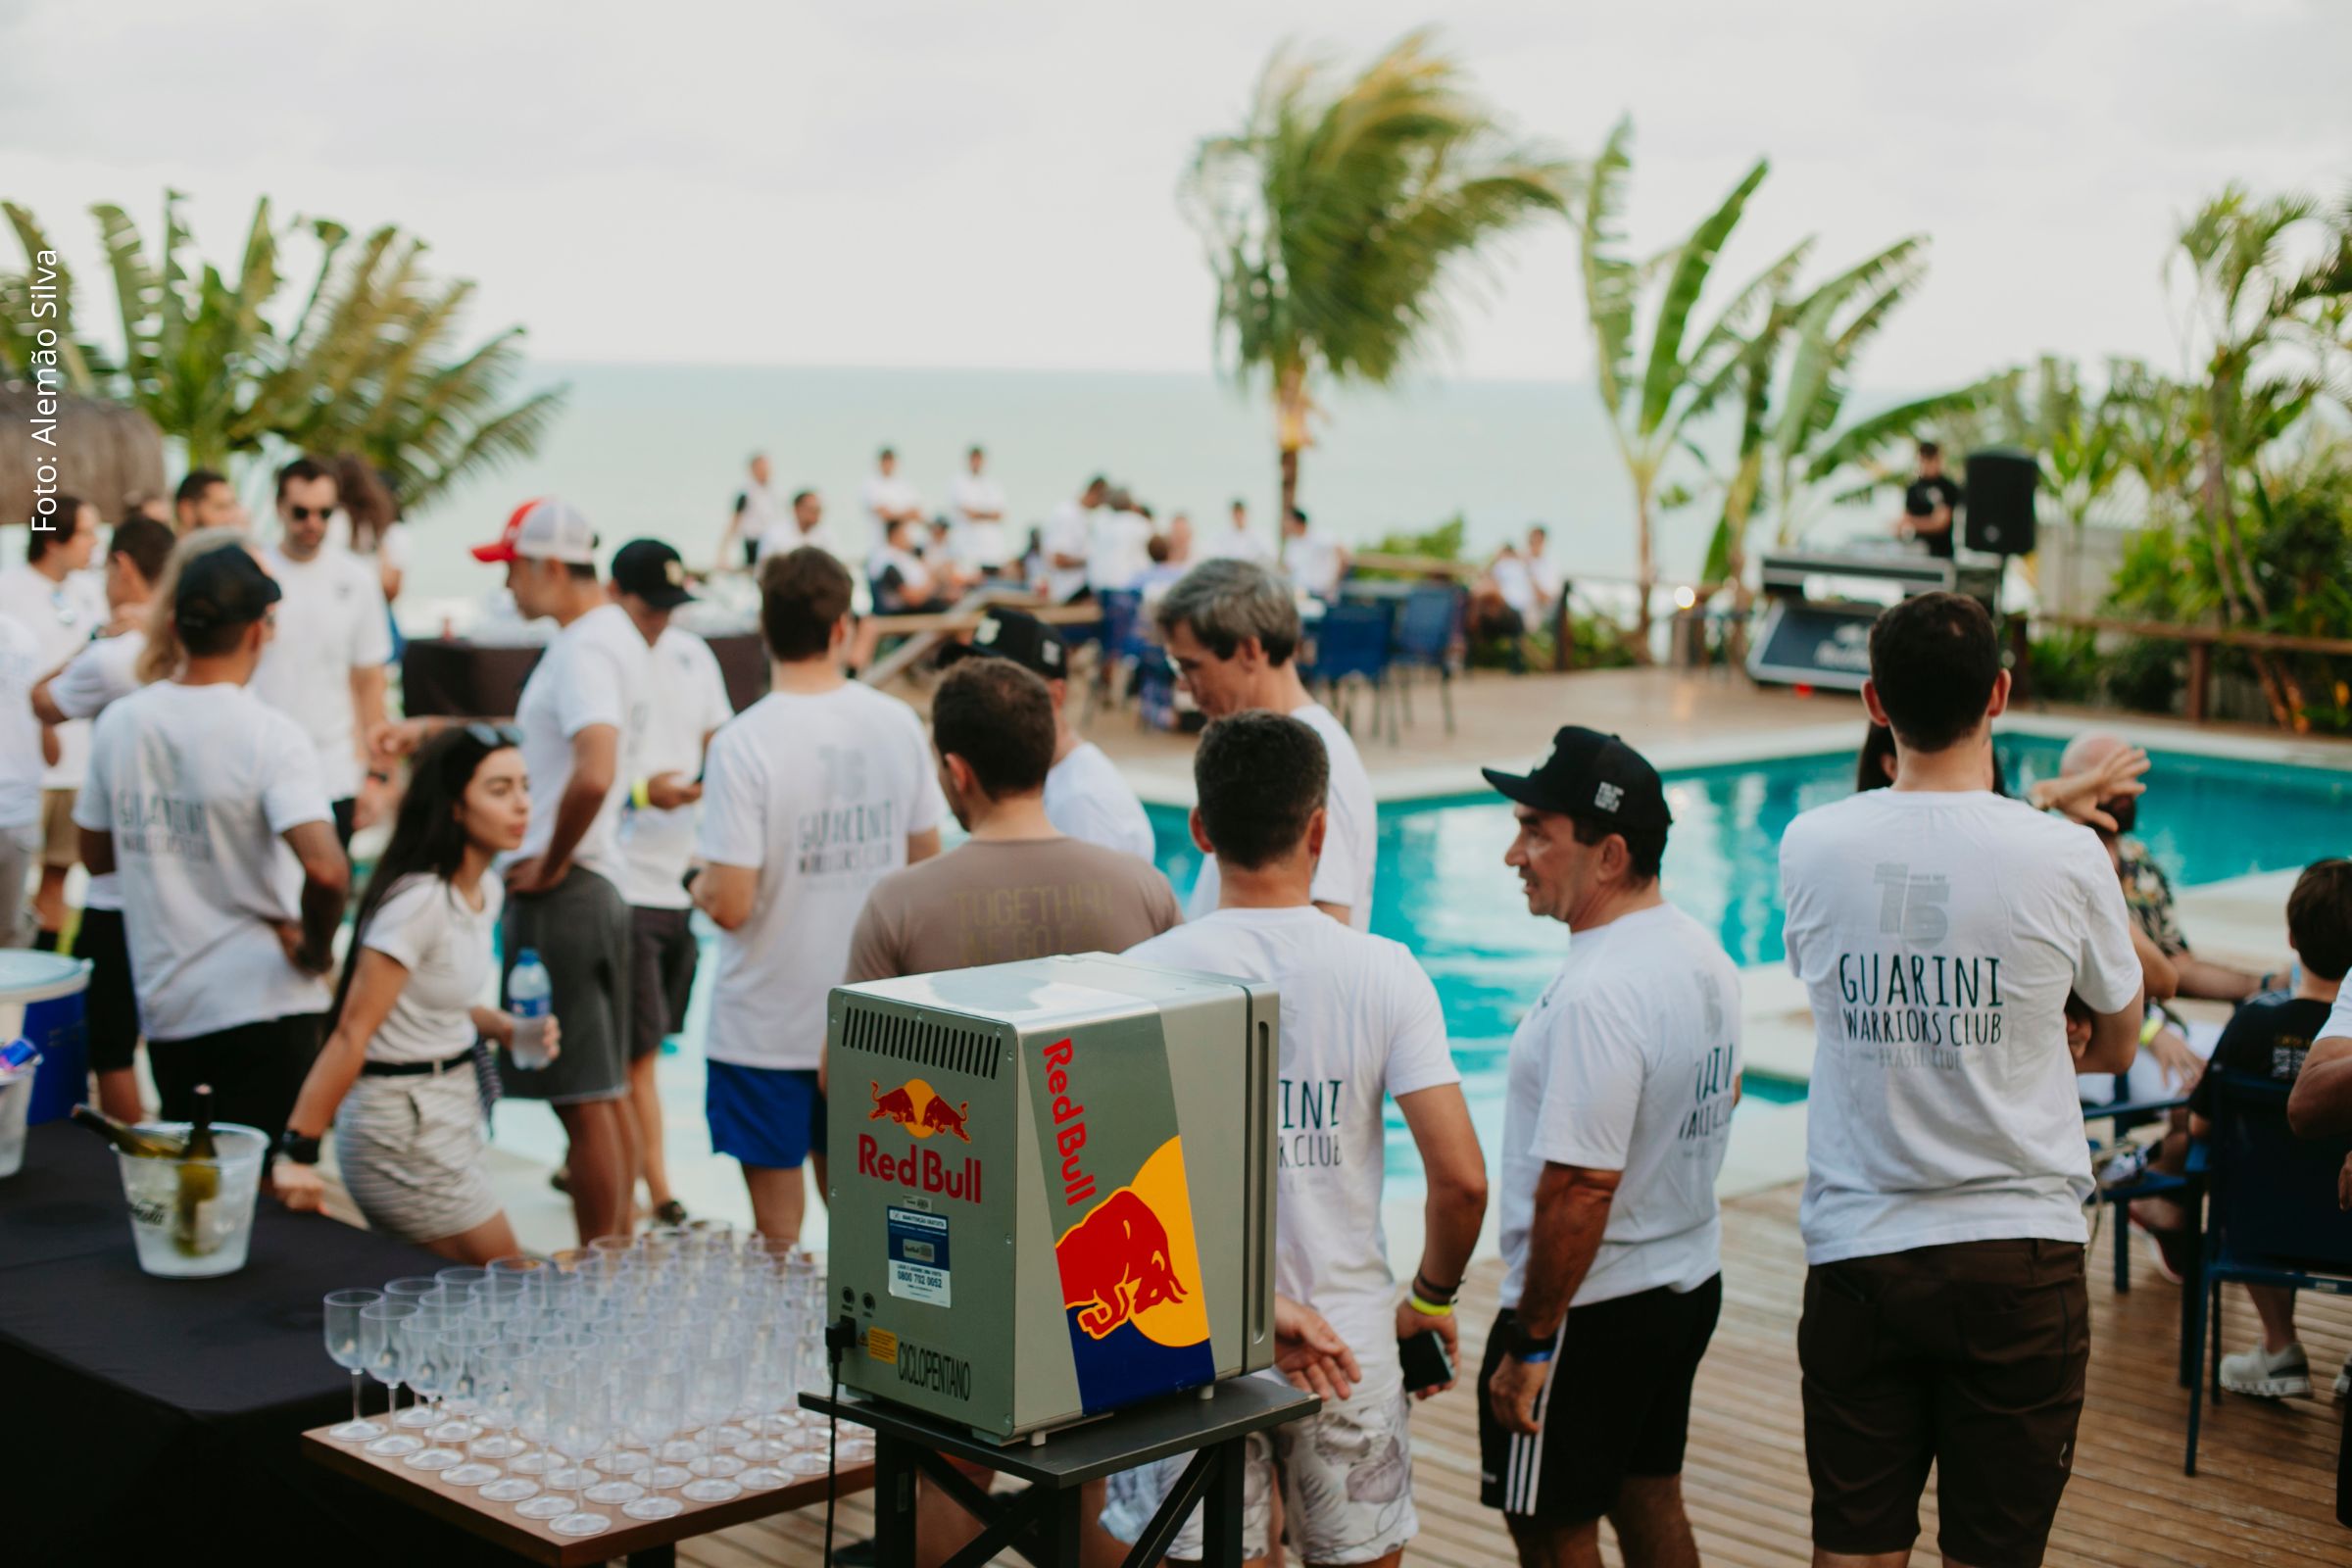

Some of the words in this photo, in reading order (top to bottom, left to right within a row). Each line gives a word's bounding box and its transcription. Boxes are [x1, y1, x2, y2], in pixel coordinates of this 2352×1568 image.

[1839, 953, 2003, 1007] GUARINI
[1843, 1006, 1942, 1046] WARRIORS
[1949, 1012, 2002, 1047] CLUB
[1043, 1037, 1085, 1126] Red
[858, 1133, 917, 1188] Red
[923, 1149, 982, 1204] Bull
[1056, 1121, 1097, 1206] Bull
[898, 1341, 971, 1401] CICLOPENTANO
